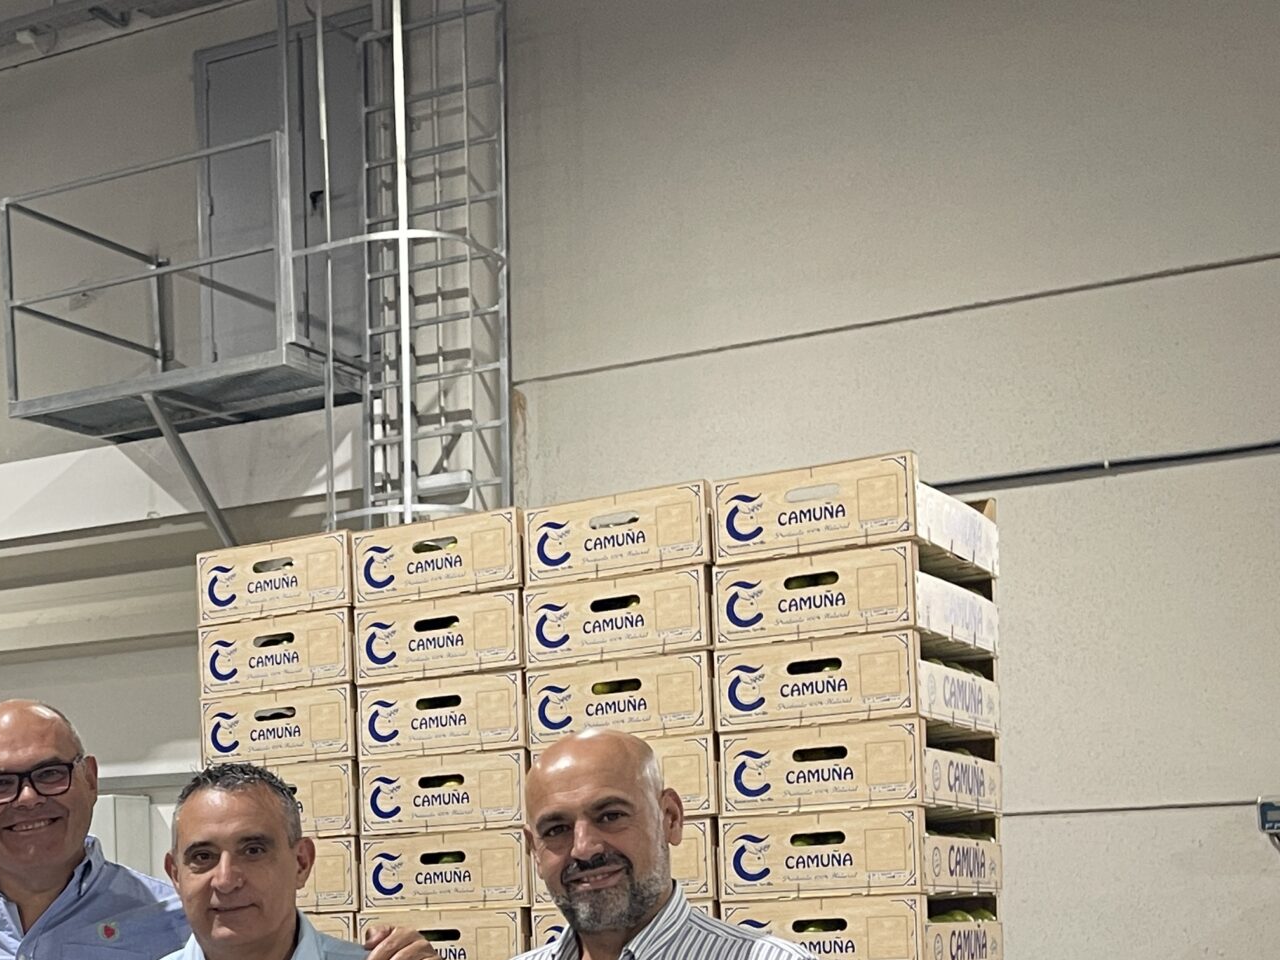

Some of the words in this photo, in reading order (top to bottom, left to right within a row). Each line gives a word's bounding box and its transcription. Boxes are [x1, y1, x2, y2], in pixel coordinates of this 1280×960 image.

[778, 501, 846, 527] CAMUÑA
[584, 529, 646, 551] CAMUÑA
[406, 553, 463, 575] CAMUÑA
[247, 574, 298, 594] CAMUÑA
[778, 590, 846, 613] CAMUÑA
[583, 612, 645, 635] CAMUÑA
[408, 632, 465, 652] CAMUÑA
[248, 649, 299, 669] CAMUÑA
[780, 675, 848, 698] CAMUÑA
[585, 696, 647, 718] CAMUÑA
[410, 711, 467, 731] CAMUÑA
[250, 723, 301, 742] CAMUÑA
[786, 763, 854, 785] CAMUÑA
[947, 760, 986, 798] CAMUÑA
[413, 789, 470, 808] CAMUÑA
[785, 849, 854, 870] CAMUÑA
[948, 843, 986, 879] CAMUÑA
[415, 867, 472, 885] CAMUÑA
[437, 944, 467, 960] UÑA
[800, 936, 856, 955] AMUÑA
